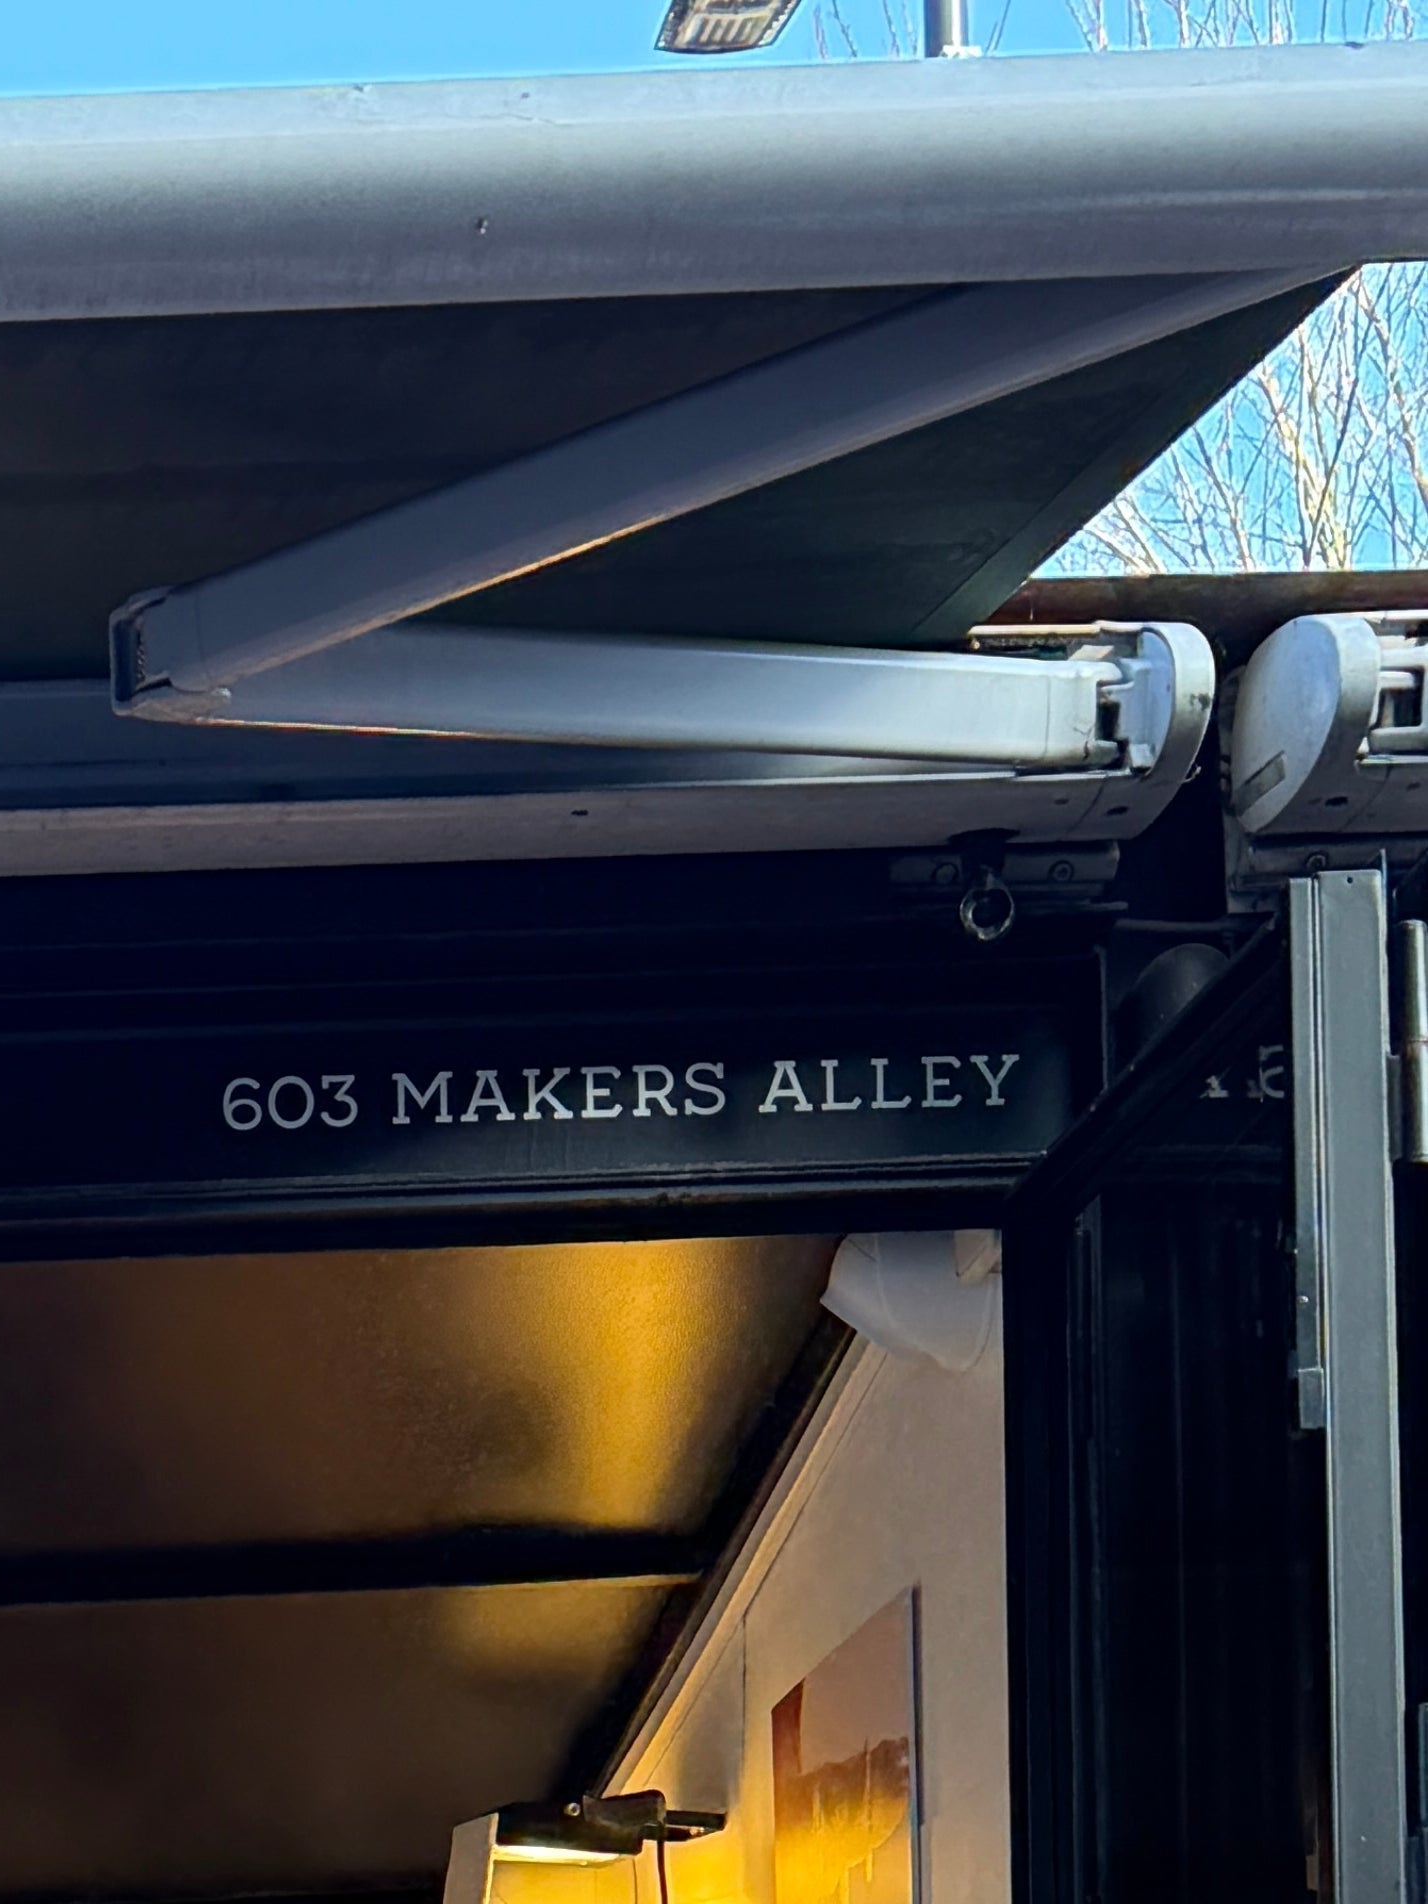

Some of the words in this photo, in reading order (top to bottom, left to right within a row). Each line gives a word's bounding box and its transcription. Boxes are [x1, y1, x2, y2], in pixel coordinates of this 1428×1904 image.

[221, 1073, 360, 1131] 603
[391, 1061, 728, 1126] MAKERS
[758, 1053, 1022, 1113] ALLEY
